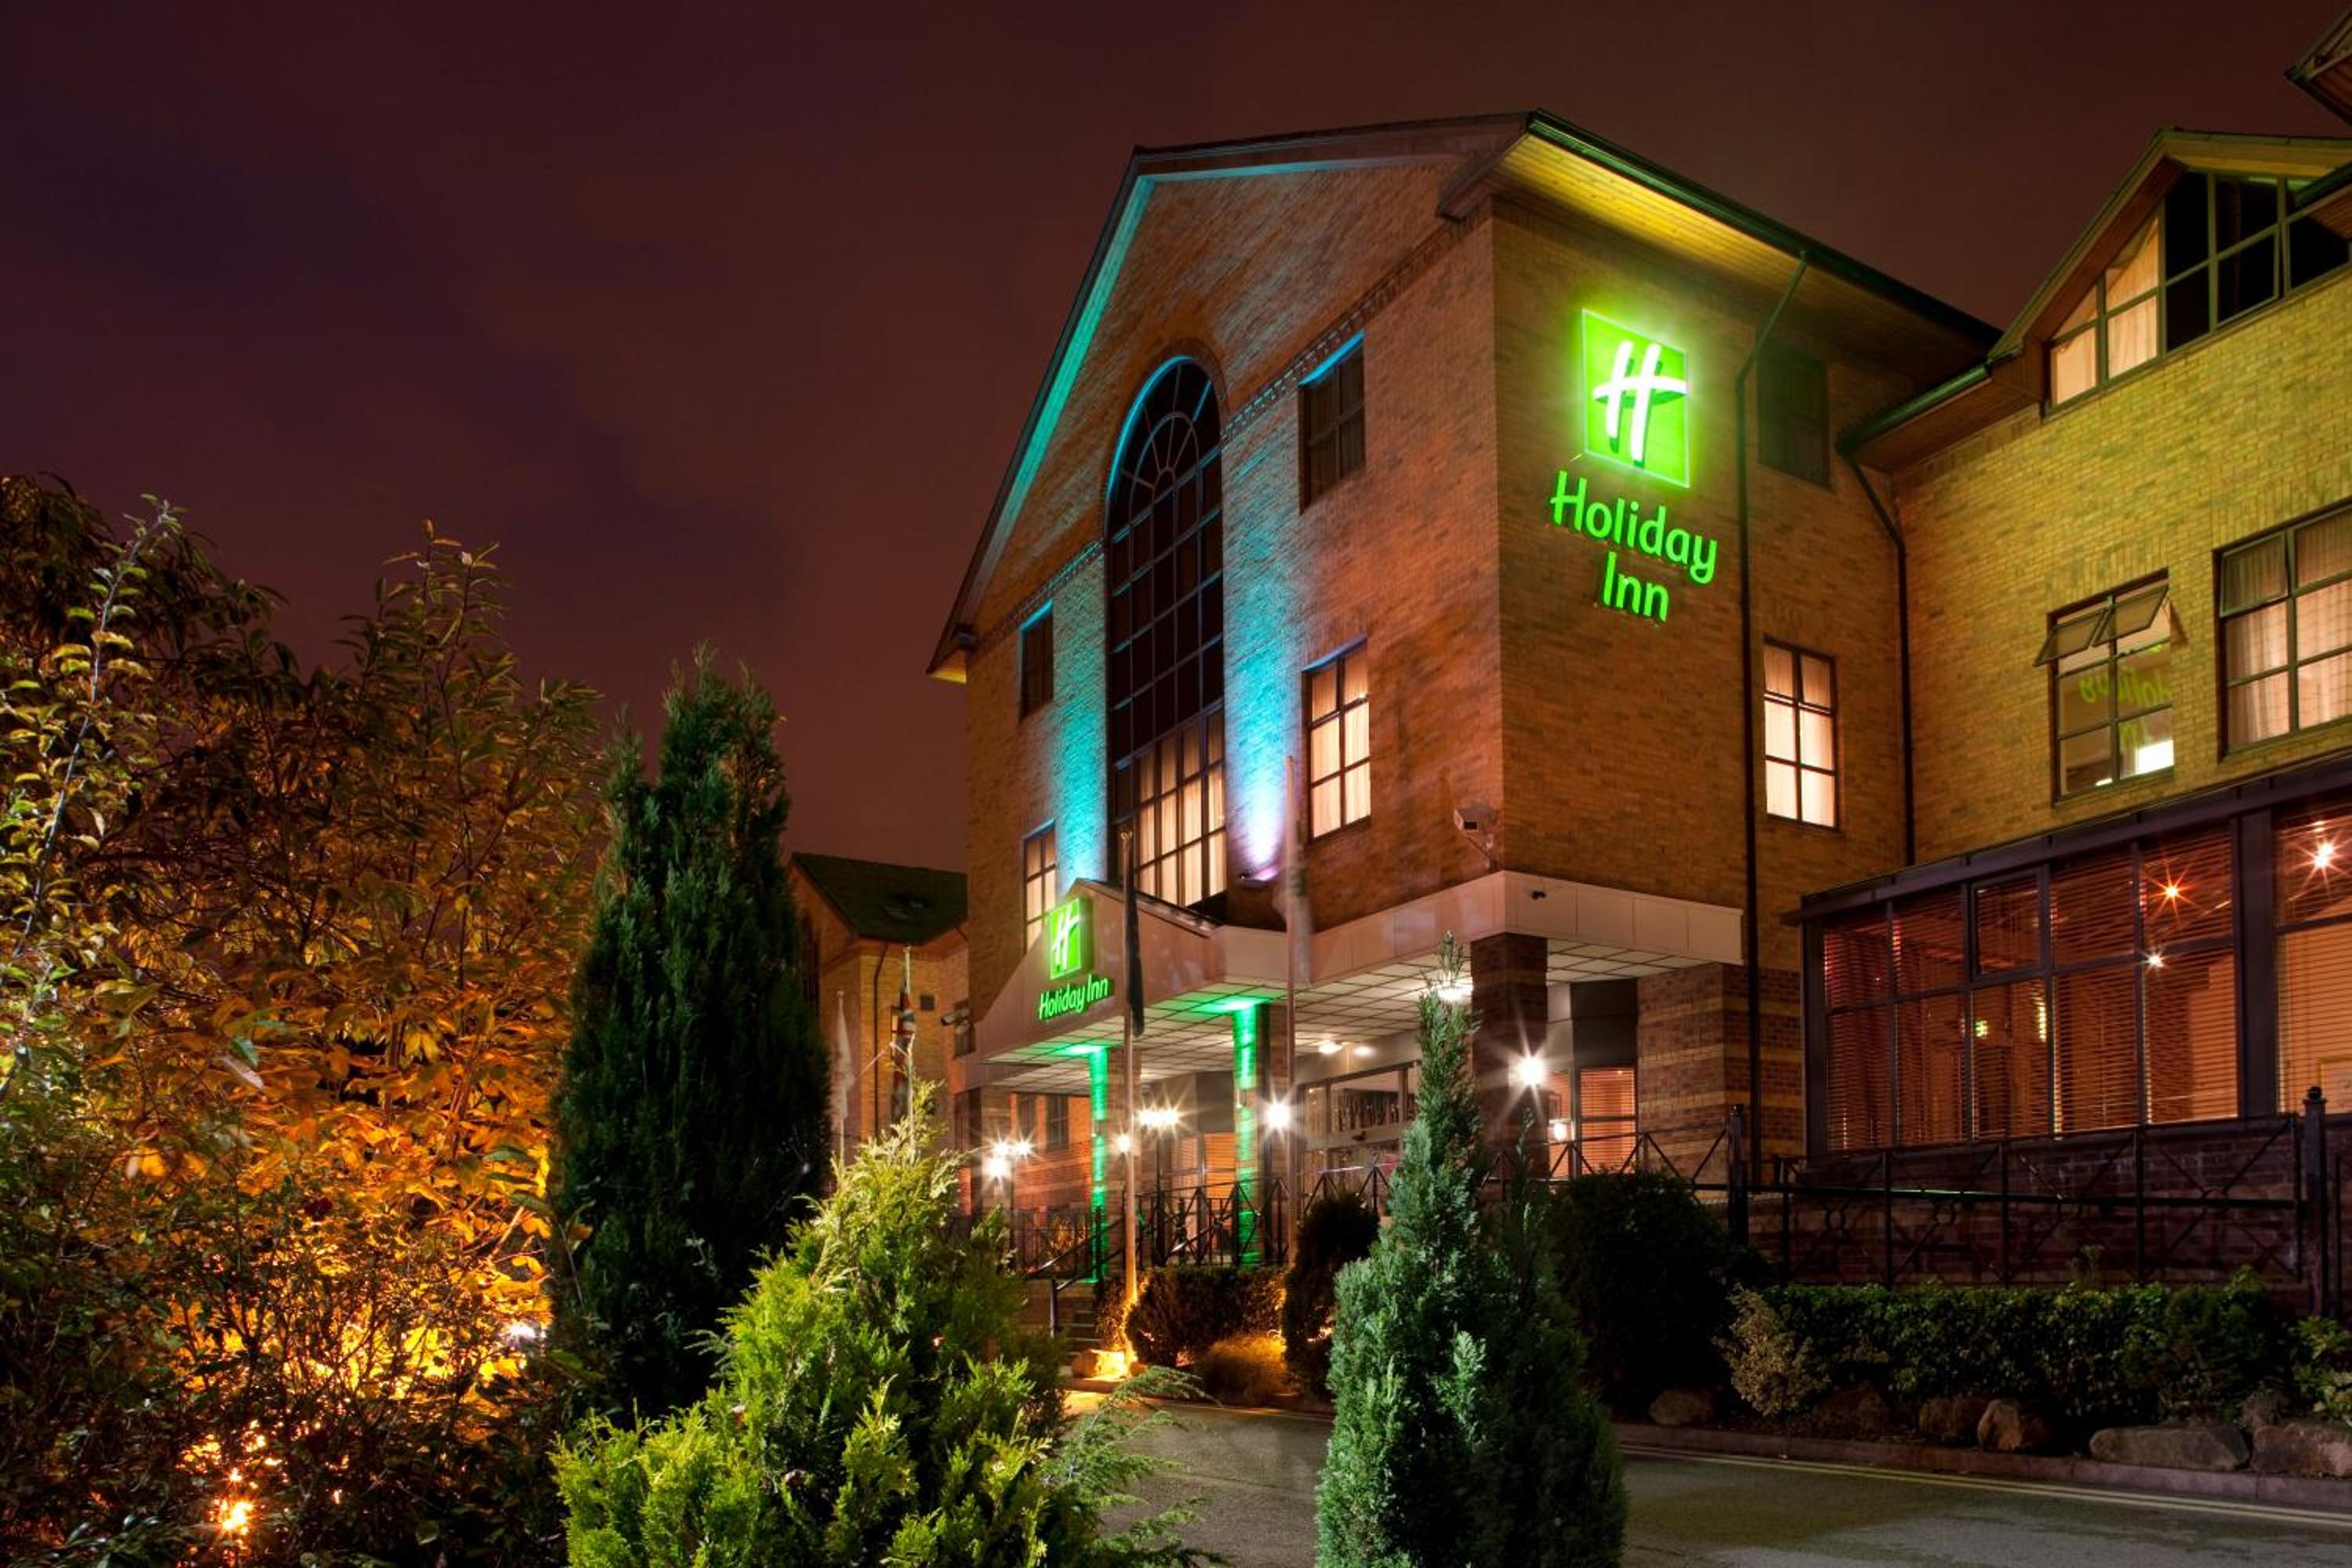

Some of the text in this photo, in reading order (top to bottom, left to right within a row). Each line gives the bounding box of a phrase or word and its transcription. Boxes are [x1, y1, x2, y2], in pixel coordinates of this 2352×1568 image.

[1550, 470, 1718, 585] Holiday
[1602, 551, 1669, 622] Inn
[1039, 973, 1108, 1020] Holiday Inn
